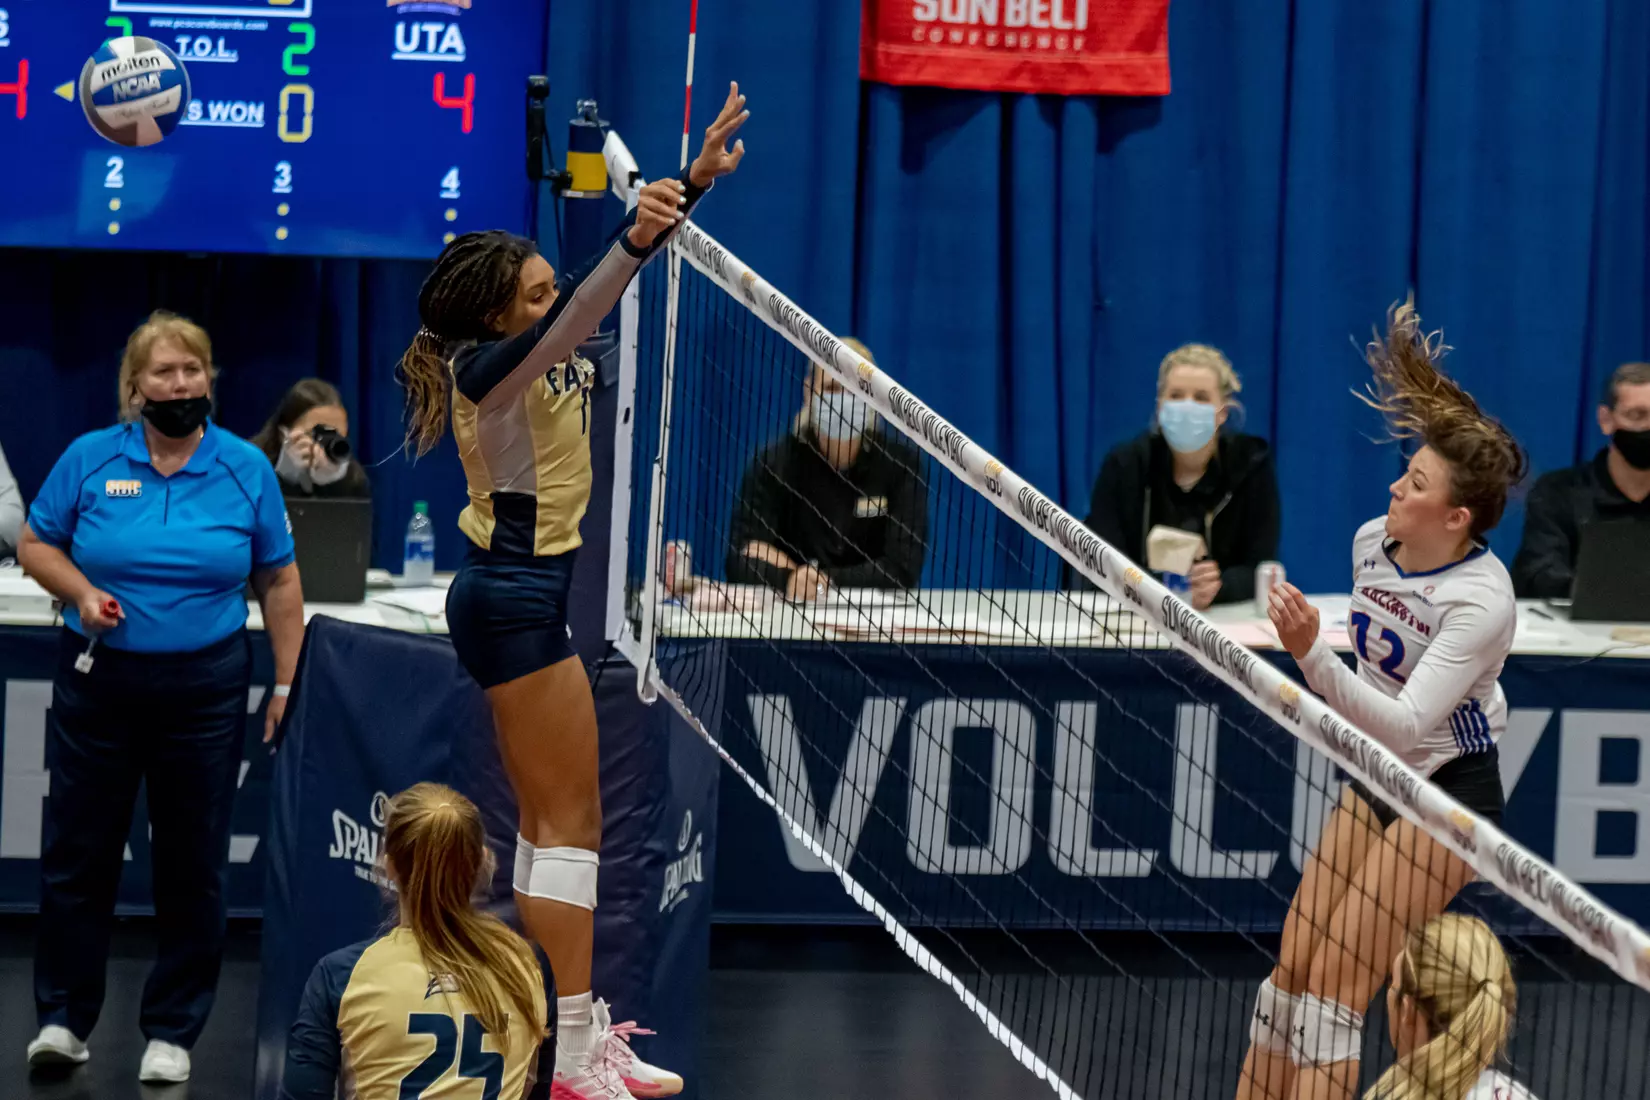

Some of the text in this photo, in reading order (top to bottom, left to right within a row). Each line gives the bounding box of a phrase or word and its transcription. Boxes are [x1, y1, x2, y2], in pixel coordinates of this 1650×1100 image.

[912, 0, 999, 26] SUN
[175, 34, 238, 60] T.O.L.
[282, 22, 316, 76] 2
[394, 21, 466, 55] UTA
[912, 27, 1085, 50] CONFERENCE
[101, 55, 161, 83] molten
[111, 73, 162, 102] NCAA
[208, 100, 265, 124] WON
[277, 84, 314, 143] 0
[433, 72, 475, 134] 4
[106, 155, 124, 182] 2
[274, 160, 292, 188] 3
[441, 167, 461, 191] 4
[1350, 609, 1406, 684] 12
[398, 1011, 510, 1100] 25
